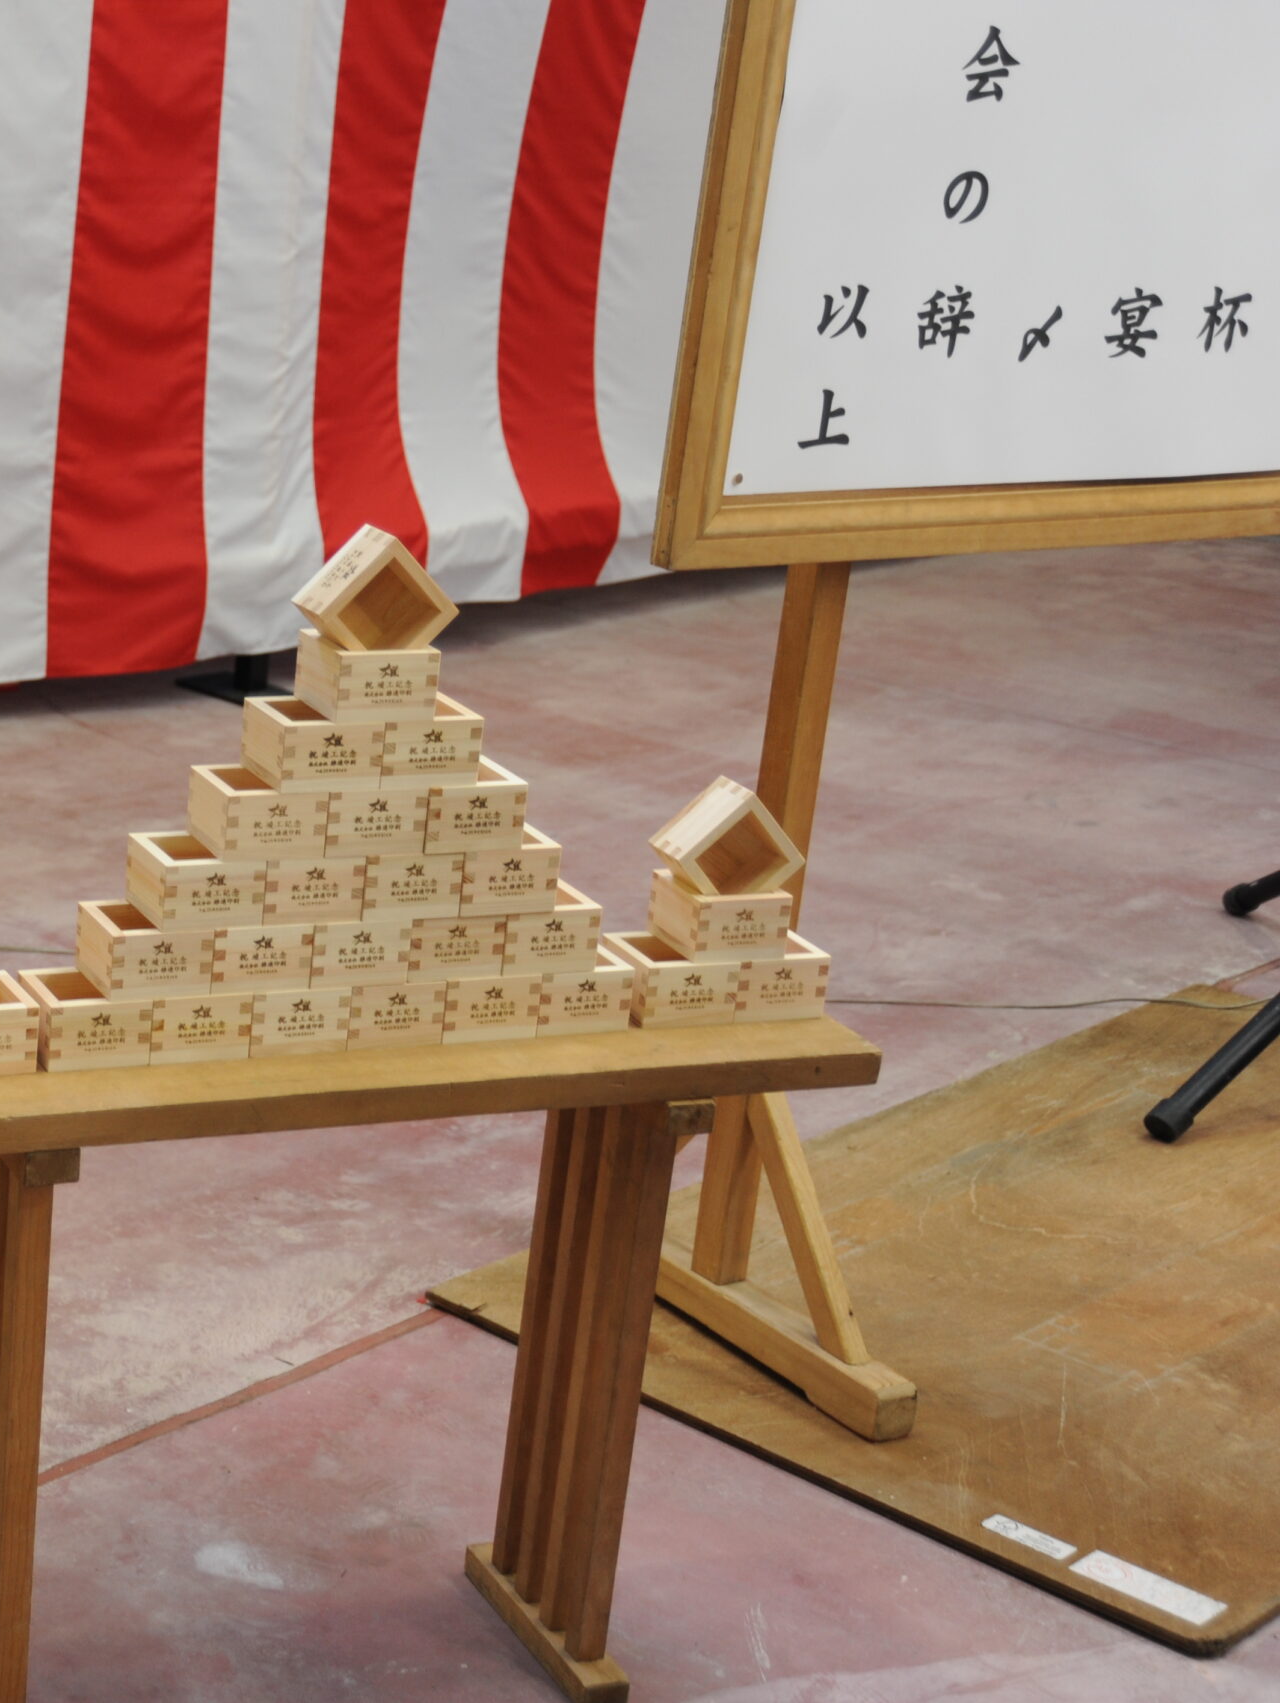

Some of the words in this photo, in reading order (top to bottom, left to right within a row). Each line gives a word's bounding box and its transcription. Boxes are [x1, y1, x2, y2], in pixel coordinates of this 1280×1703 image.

[1104, 287, 1163, 358] 宴
[1197, 286, 1252, 352] 杯
[797, 284, 870, 449] 以上
